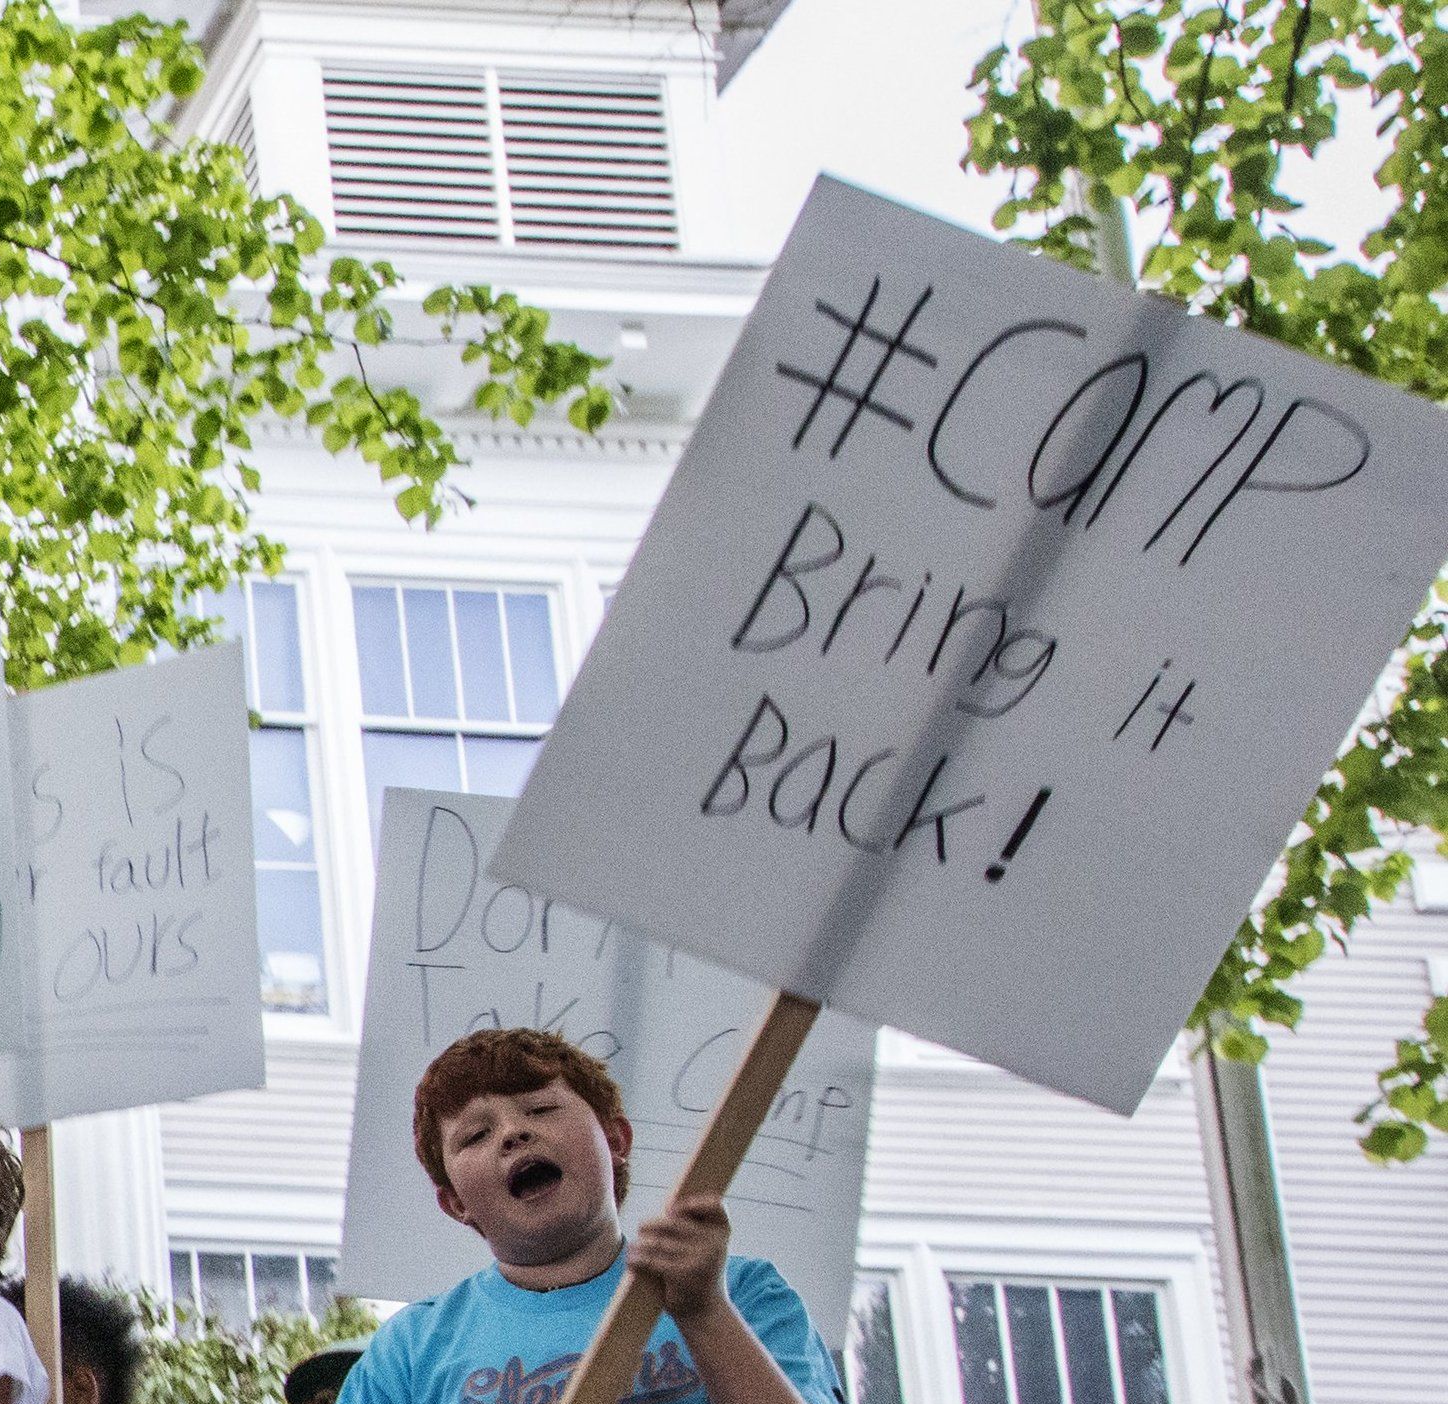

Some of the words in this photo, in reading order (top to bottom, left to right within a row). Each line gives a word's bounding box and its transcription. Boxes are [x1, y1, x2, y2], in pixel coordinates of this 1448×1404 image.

[730, 502, 1058, 719] Bring
[1111, 658, 1197, 752] it
[701, 694, 1053, 884] Back!
[671, 1027, 852, 1162] Cmp
